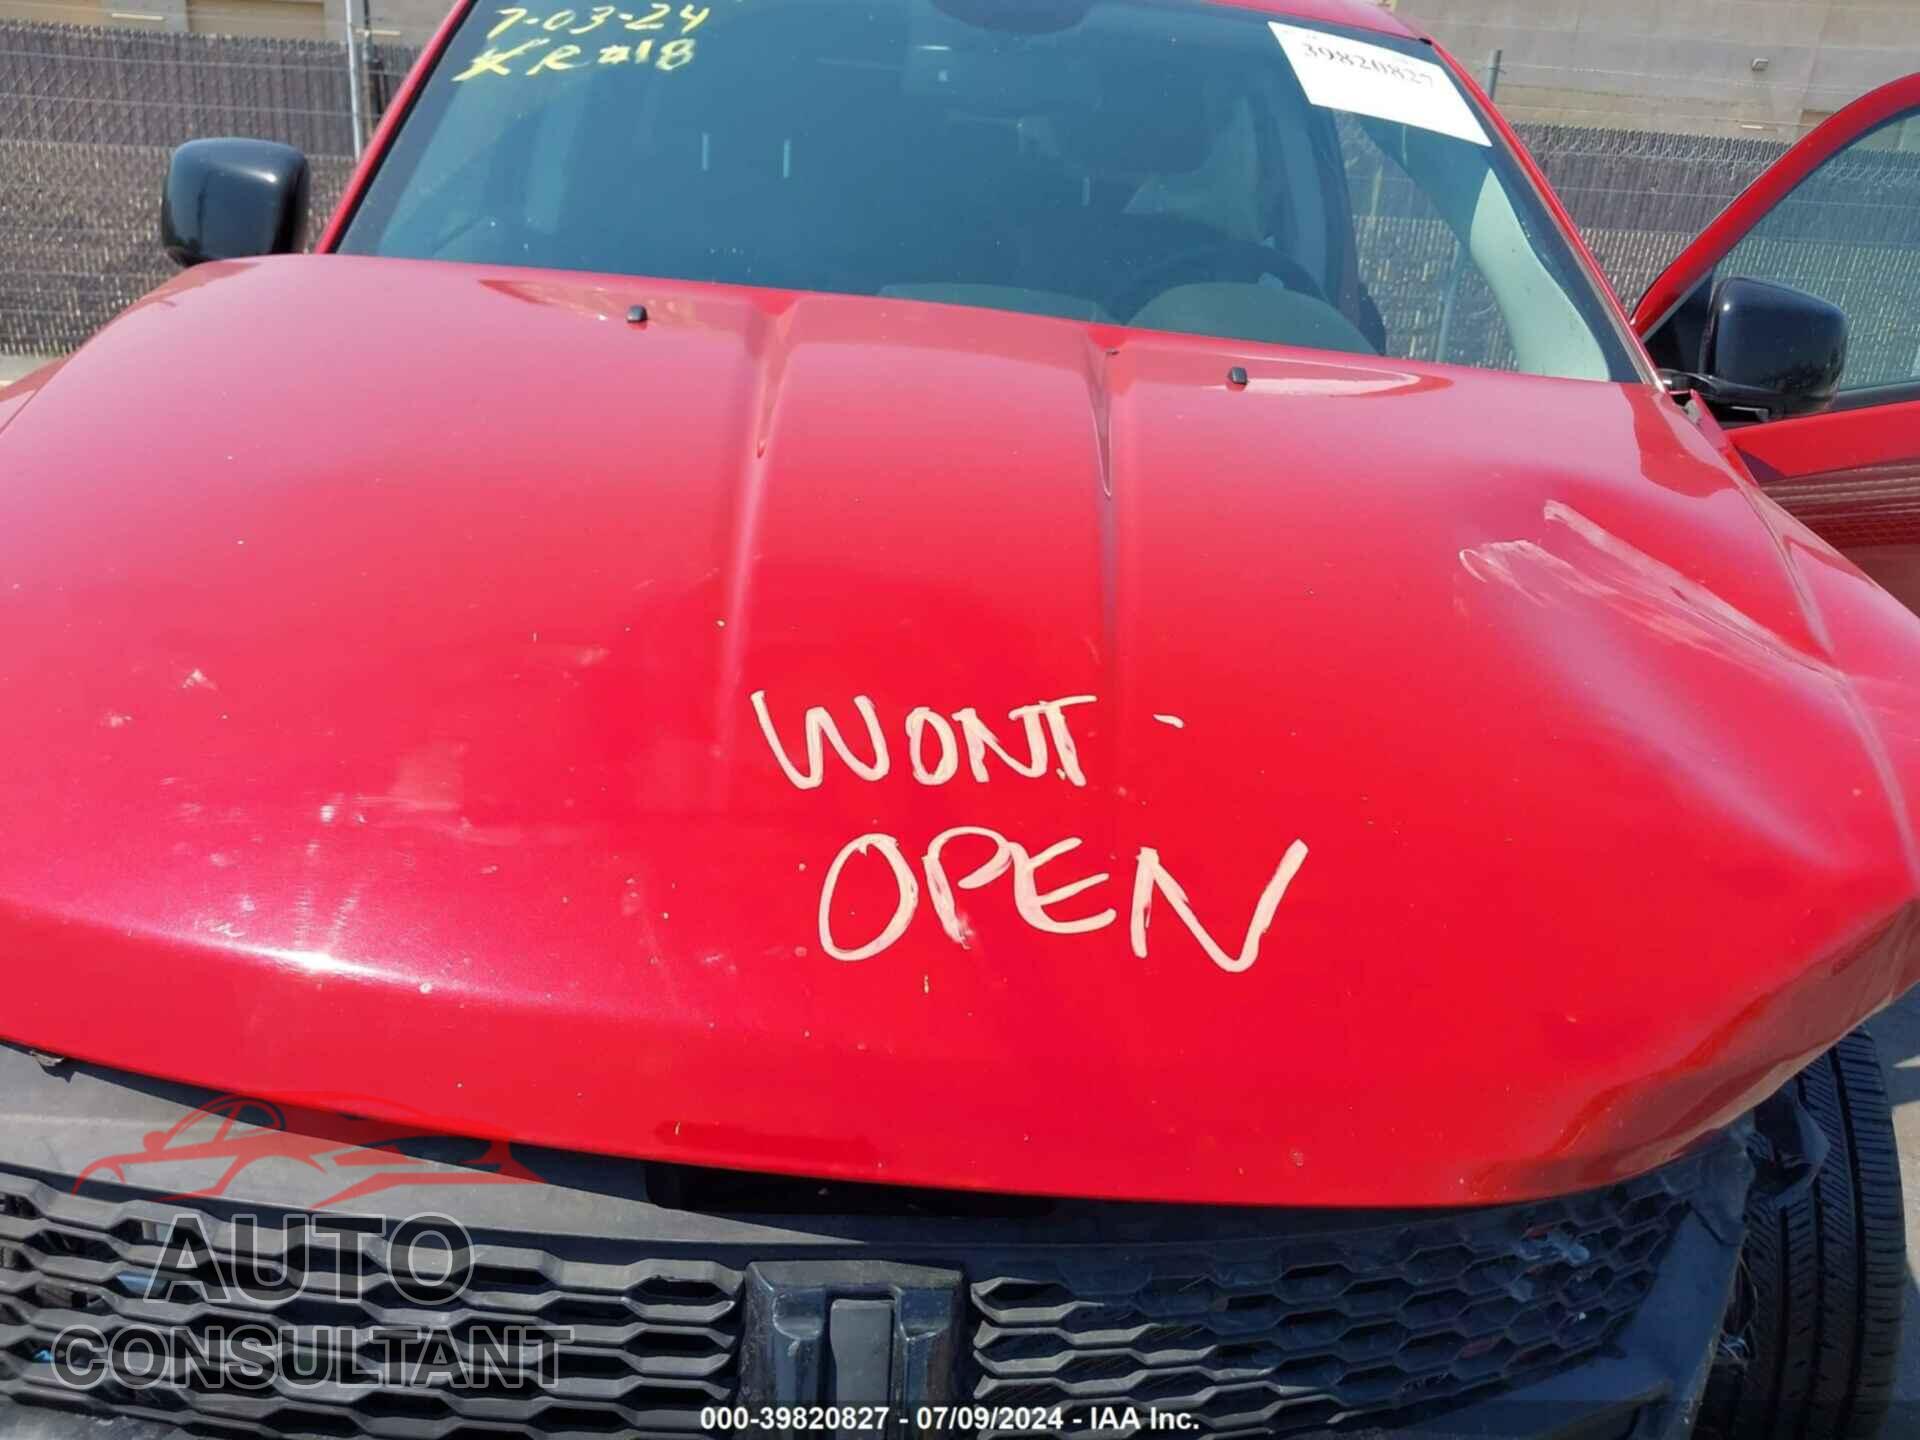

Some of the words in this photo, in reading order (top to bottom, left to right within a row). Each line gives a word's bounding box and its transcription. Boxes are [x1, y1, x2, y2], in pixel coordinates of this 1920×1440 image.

[487, 3, 710, 39] 7-03-24
[751, 690, 1097, 790] WONT
[818, 826, 1309, 973] OPEN
